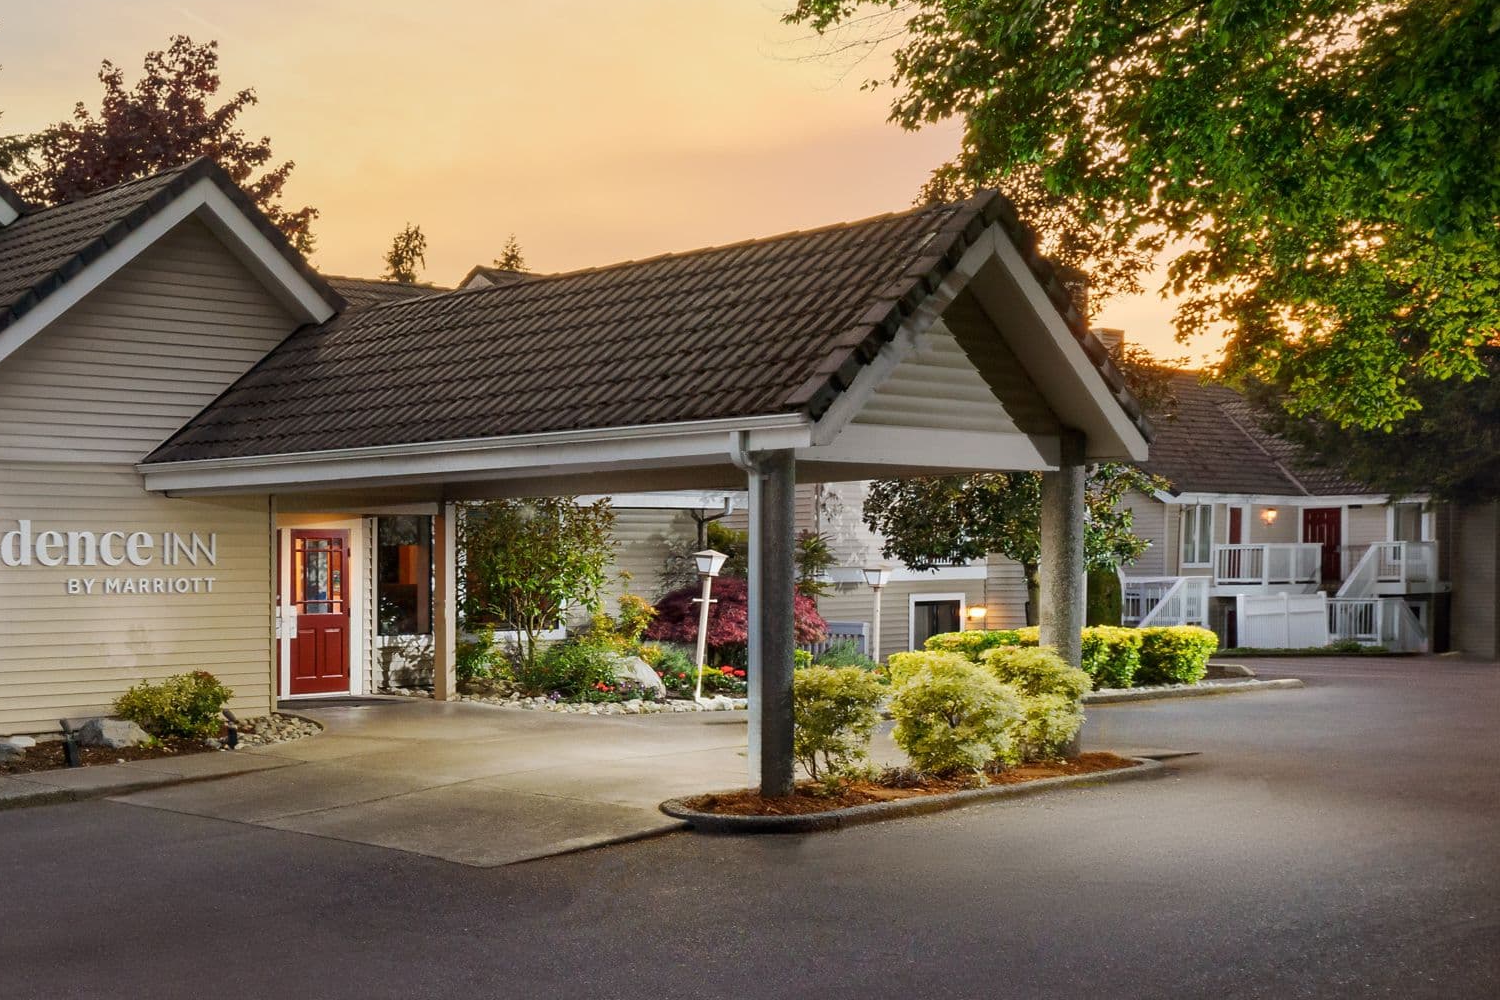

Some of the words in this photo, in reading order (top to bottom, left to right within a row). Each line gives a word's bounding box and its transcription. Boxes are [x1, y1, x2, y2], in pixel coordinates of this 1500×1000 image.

[164, 532, 216, 566] INN
[67, 578, 95, 594] BY
[106, 577, 216, 593] MARRIOTT
